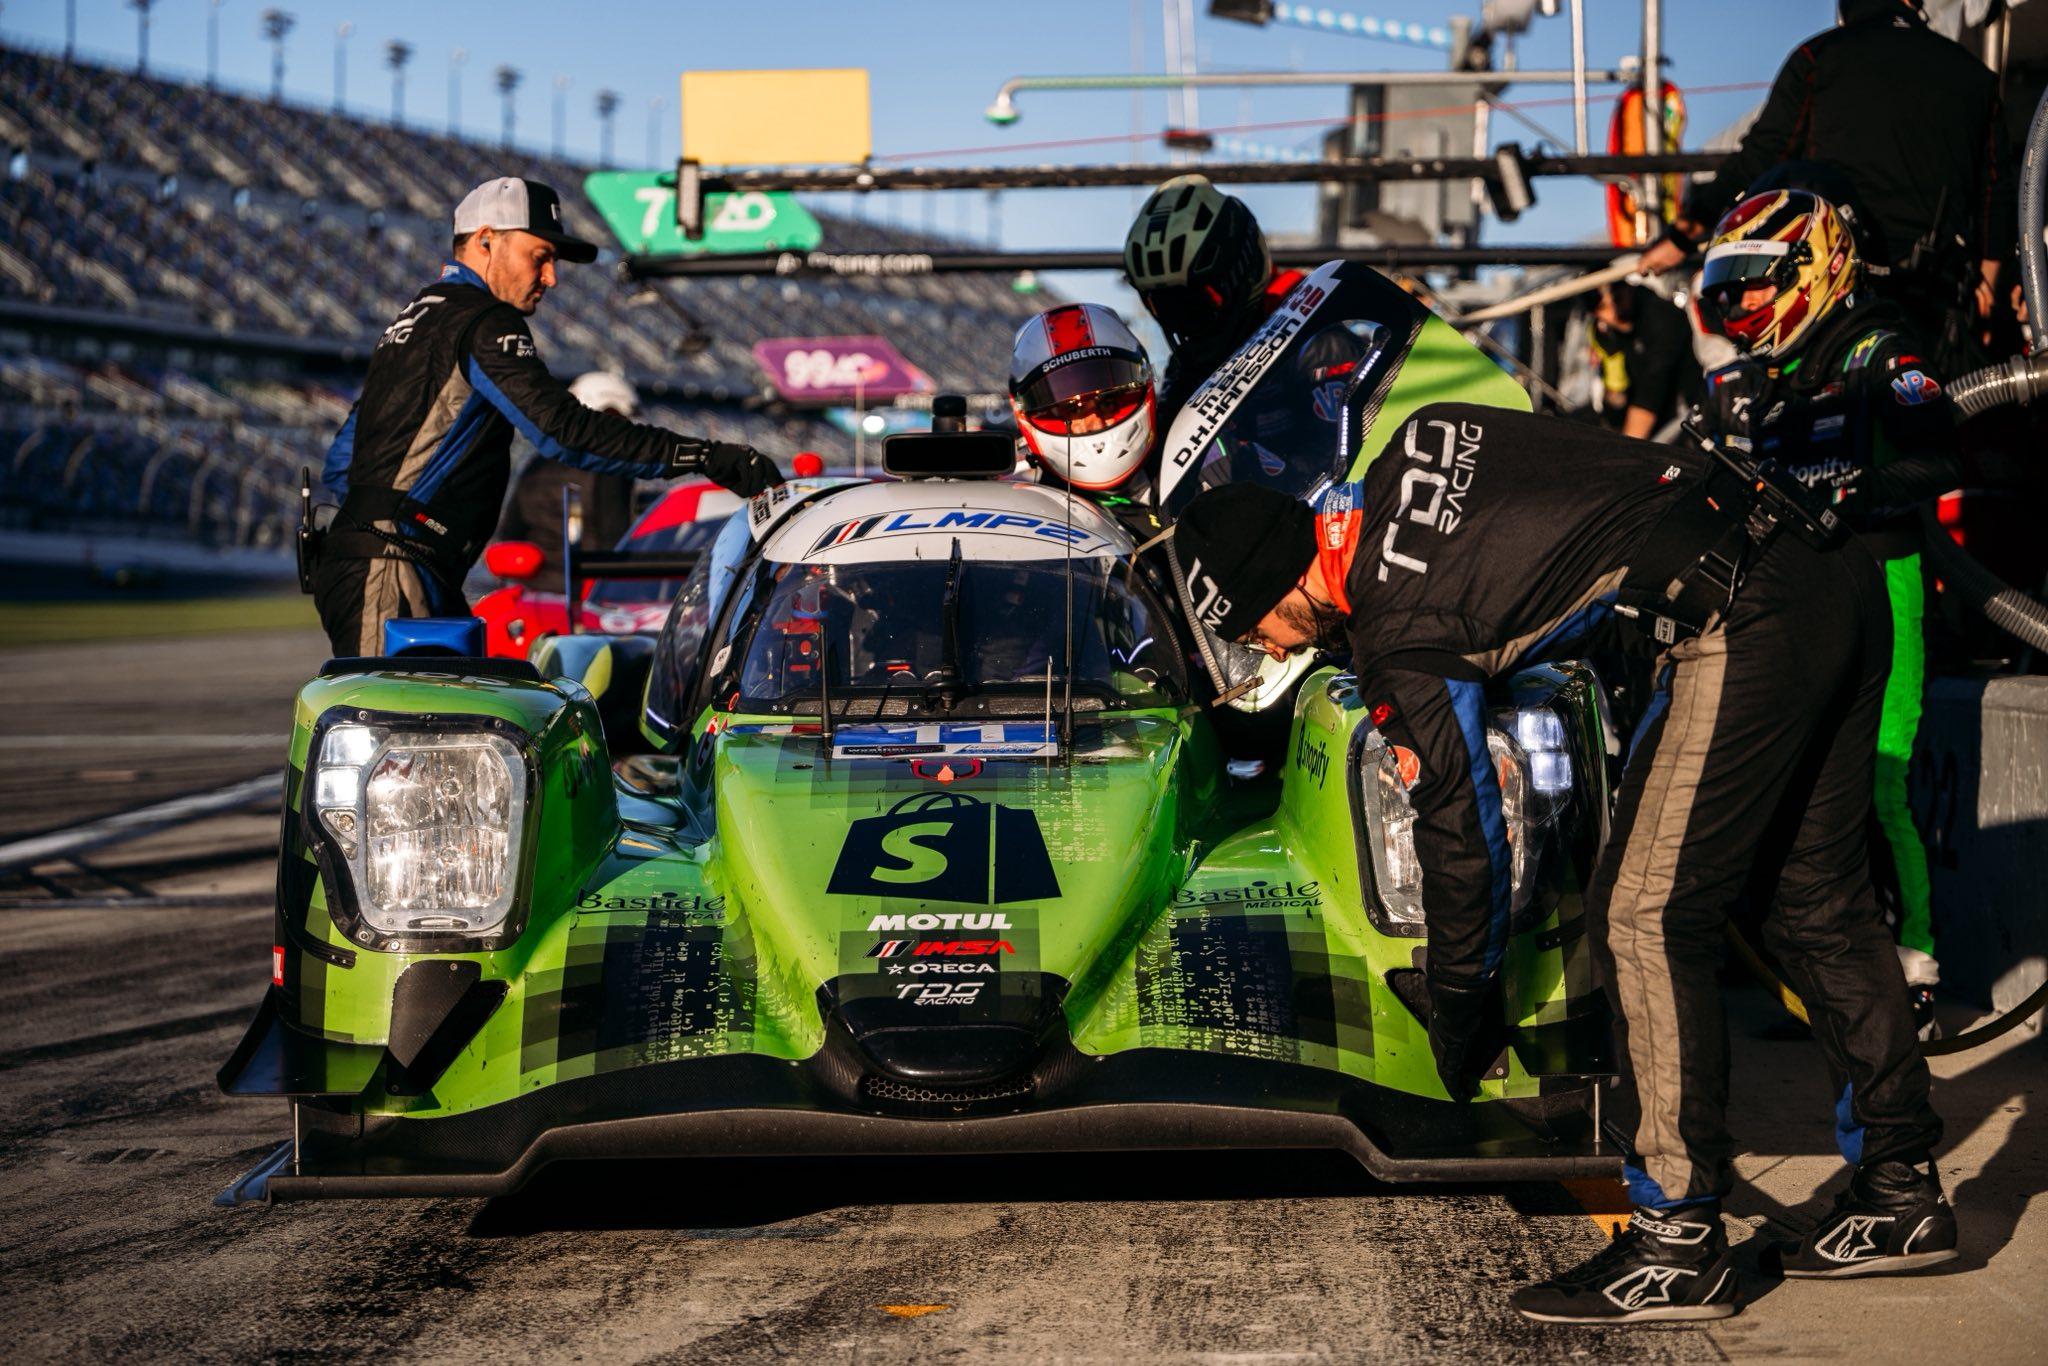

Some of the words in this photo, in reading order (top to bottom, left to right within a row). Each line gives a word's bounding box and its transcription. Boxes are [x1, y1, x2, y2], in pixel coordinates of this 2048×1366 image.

[1042, 347, 1111, 372] SCHUBERTH
[1438, 421, 1483, 535] RACING
[884, 512, 1090, 544] LMP2
[1302, 731, 1330, 791] shopify
[576, 887, 726, 910] Bastide
[1172, 880, 1322, 904] Bastide
[867, 913, 1013, 931] MOTUL
[912, 940, 1016, 956] IMSA
[908, 963, 996, 974] ORECA
[896, 982, 985, 1000] TDS
[913, 997, 976, 1006] RACING
